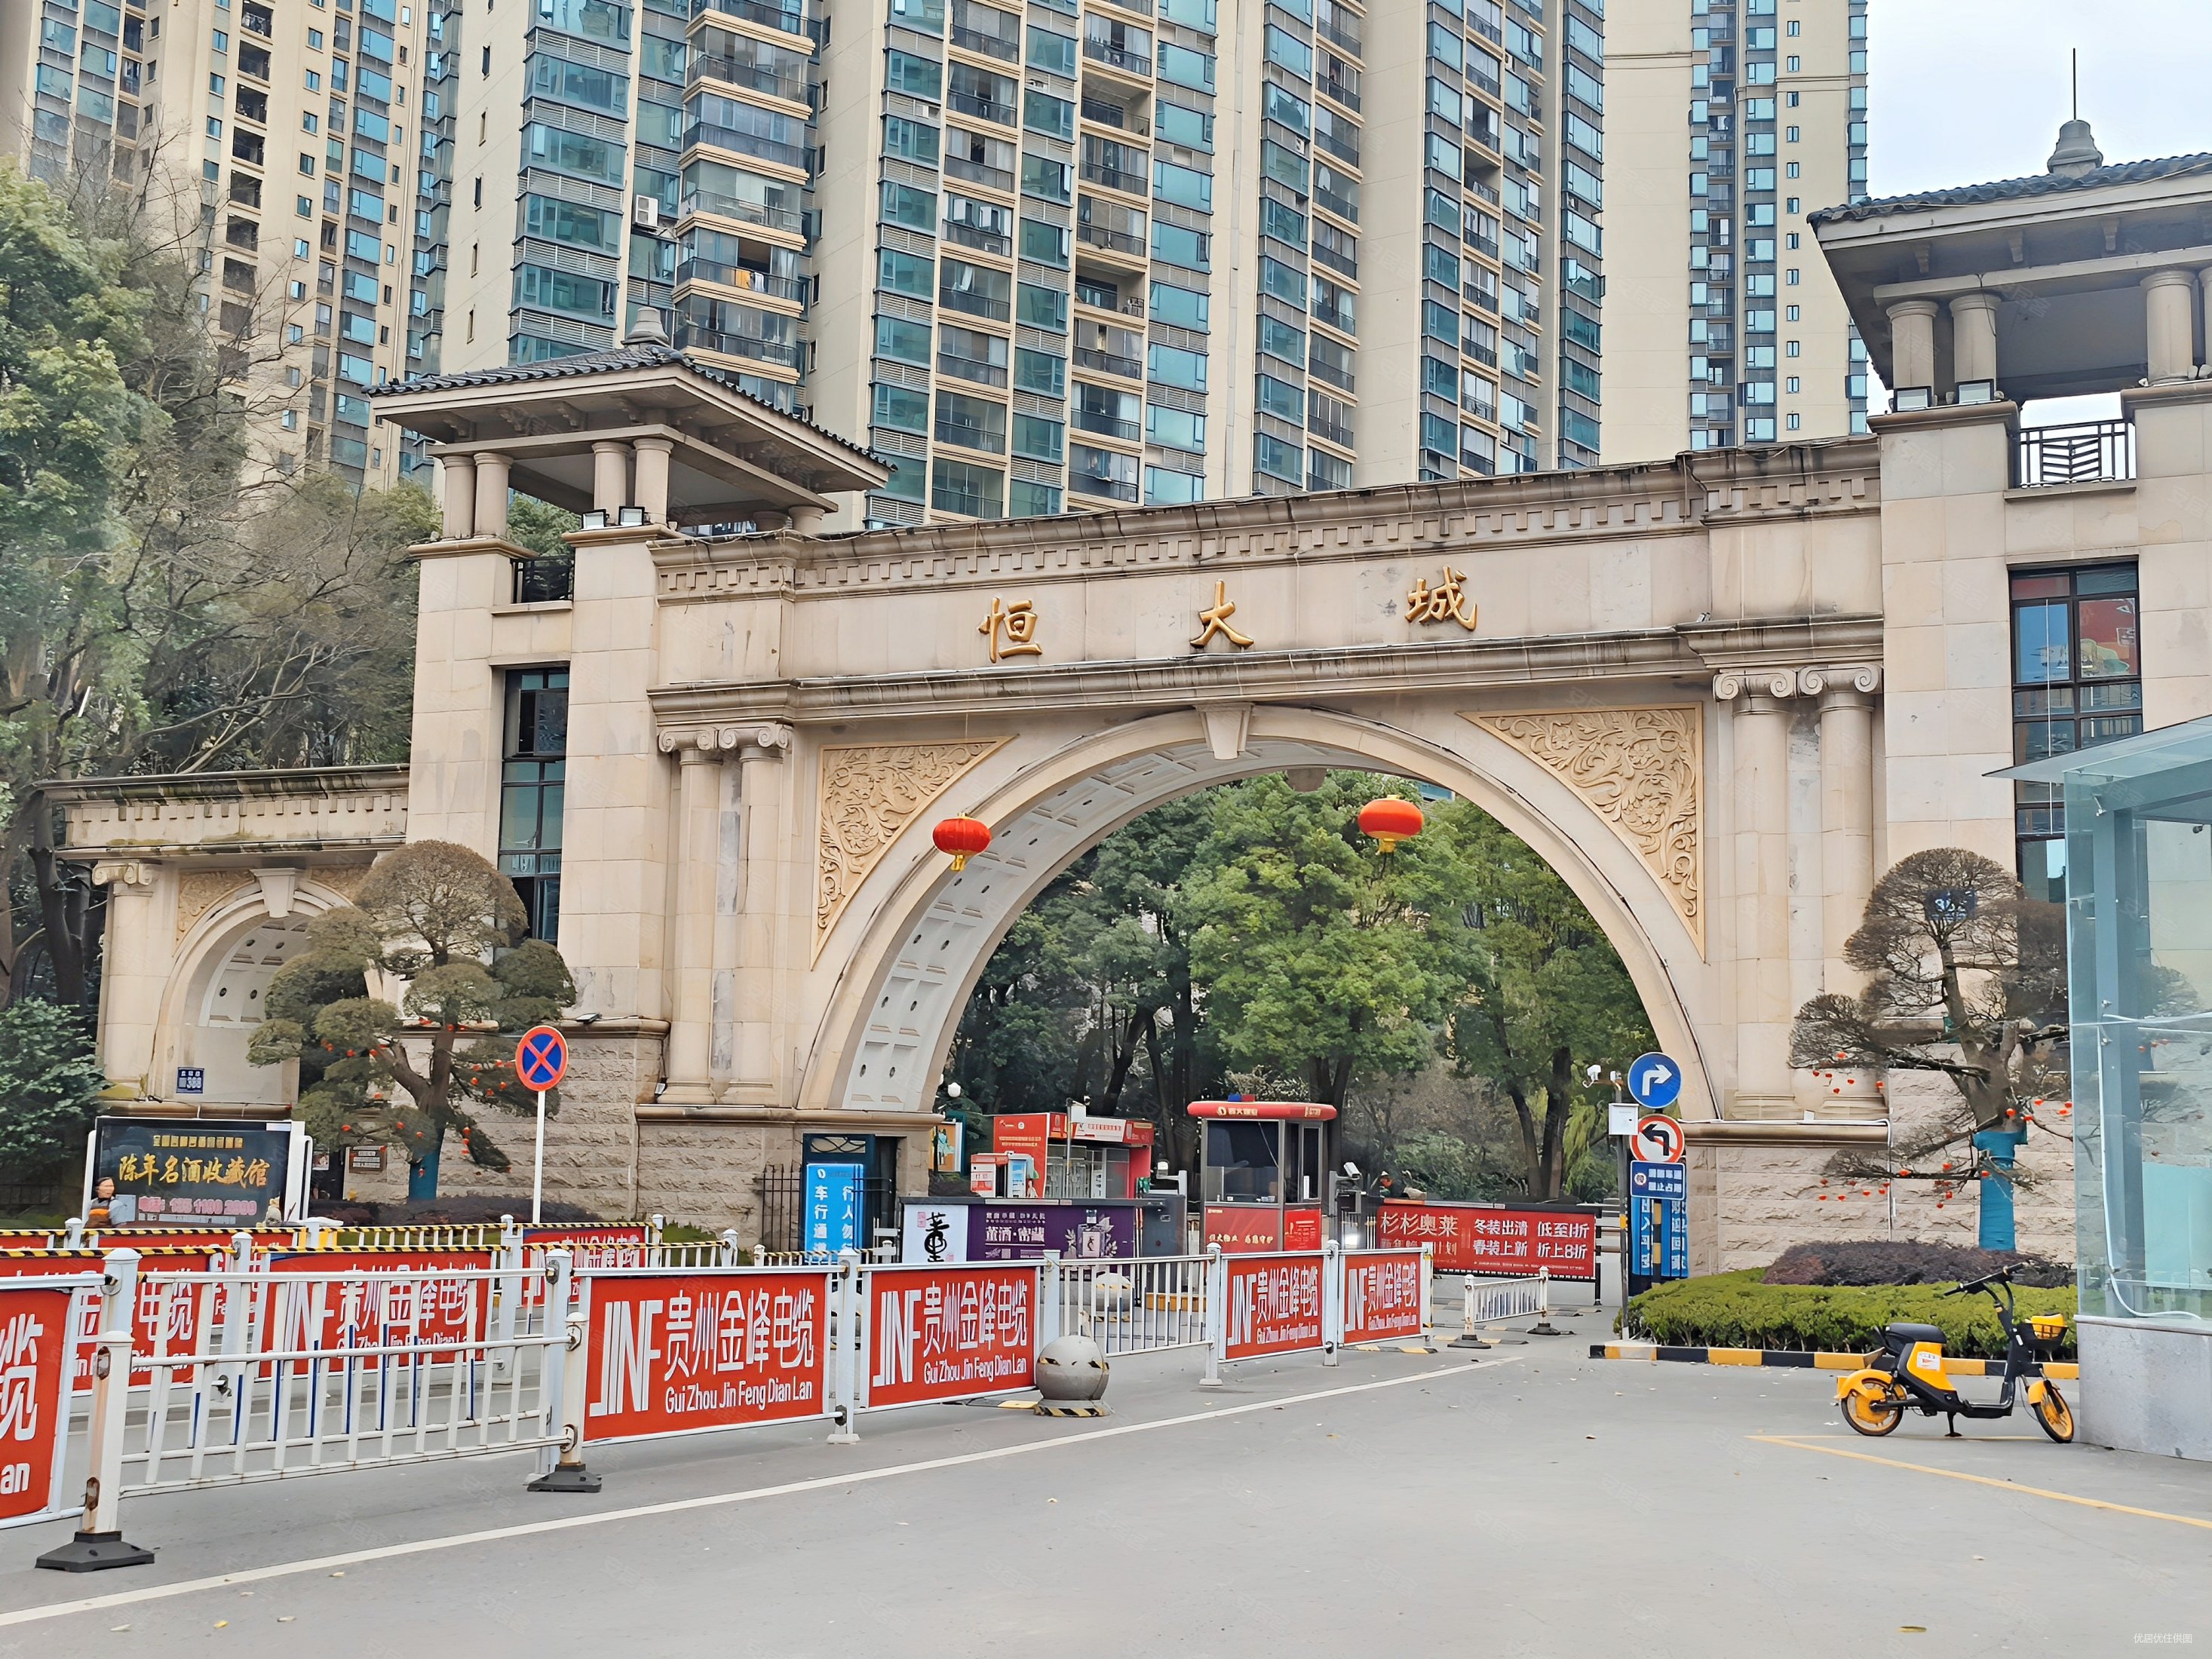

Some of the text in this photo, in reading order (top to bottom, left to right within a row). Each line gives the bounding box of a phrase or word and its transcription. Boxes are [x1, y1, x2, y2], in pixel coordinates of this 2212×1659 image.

[978, 566, 1478, 664] 恒大城
[119, 1153, 271, 1188] 陈年名酒收藏馆
[1380, 1211, 1459, 1237] 杉杉奥莱
[1474, 1219, 1528, 1237] 冬装出清
[1537, 1242, 1588, 1260] 折上8折
[664, 1286, 815, 1381] 贵州金峰电缆
[923, 1278, 1028, 1357] 贵州金峰电缆
[719, 1381, 736, 1408] Jin
[738, 1380, 765, 1410] Feng
[768, 1377, 791, 1403] Dian
[793, 1375, 812, 1400] Lan
